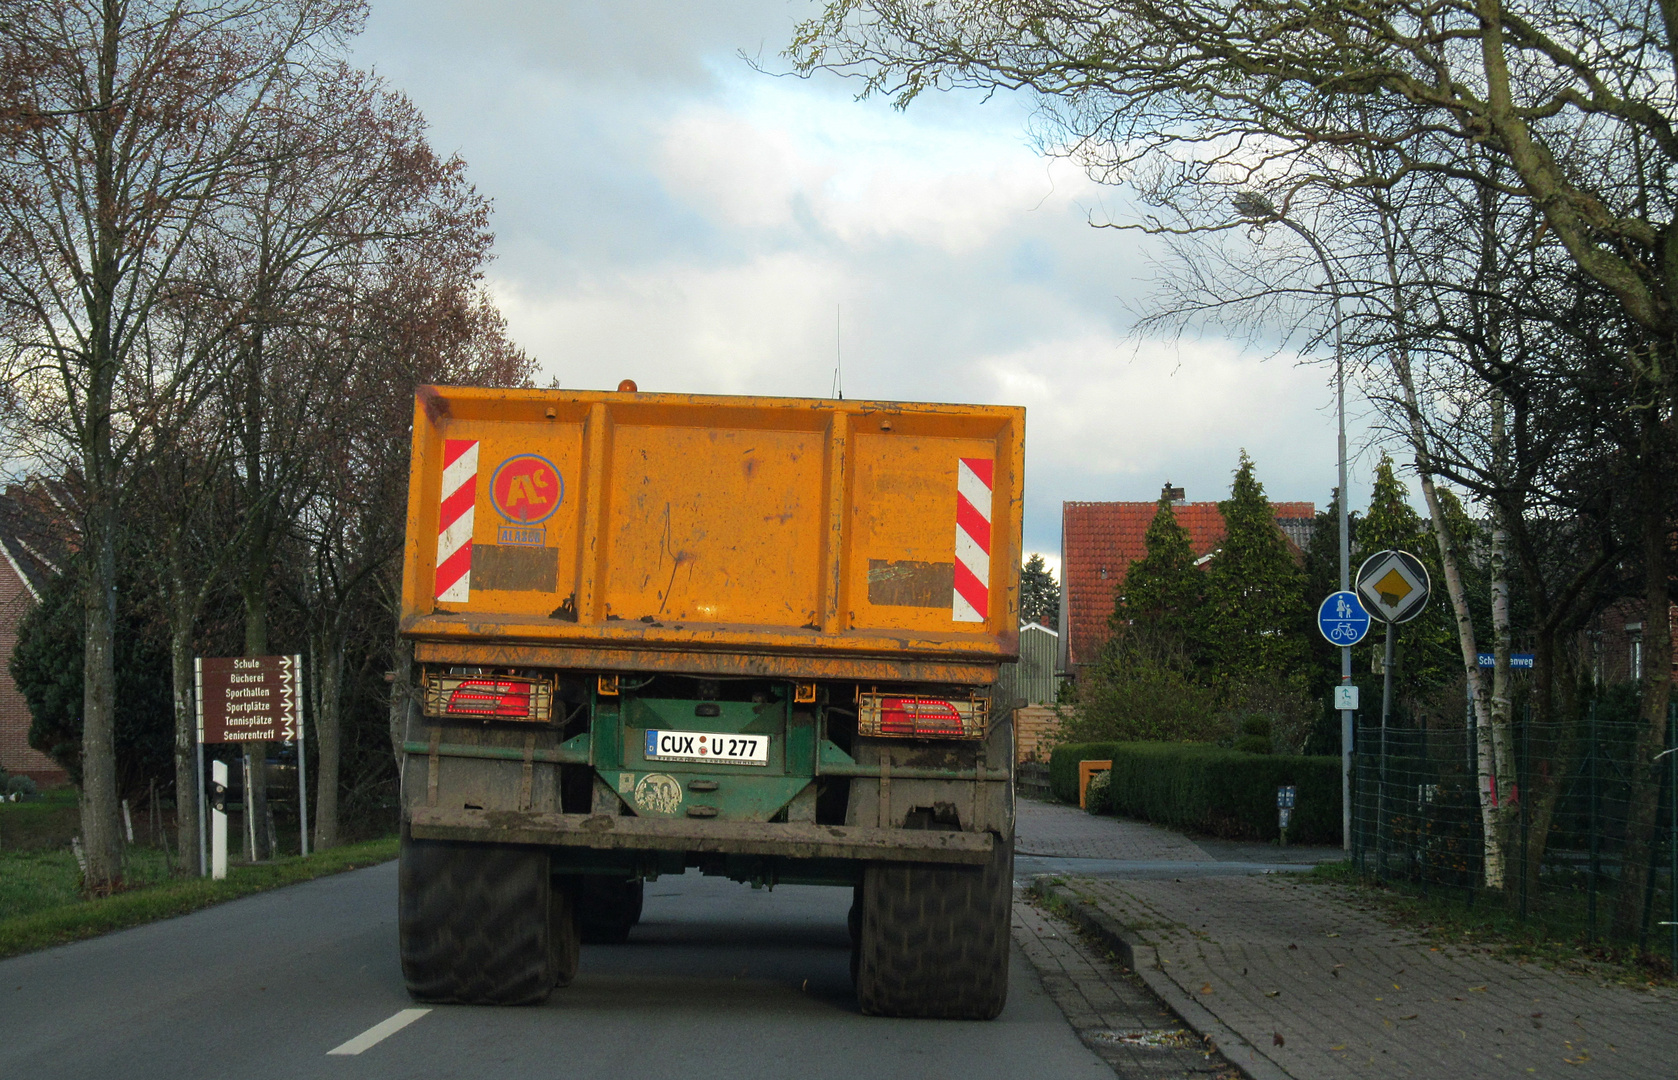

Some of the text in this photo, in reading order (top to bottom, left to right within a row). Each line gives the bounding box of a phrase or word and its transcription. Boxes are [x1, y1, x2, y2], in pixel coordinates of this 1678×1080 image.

[234, 659, 260, 669] Schule
[230, 673, 264, 684] Bücherei
[225, 687, 270, 700] Sporthallen
[226, 701, 270, 714] Sportplätze
[225, 715, 272, 727] Tennisplätze
[223, 729, 275, 741] Seniorentreff
[661, 735, 757, 757] CUX U 277
